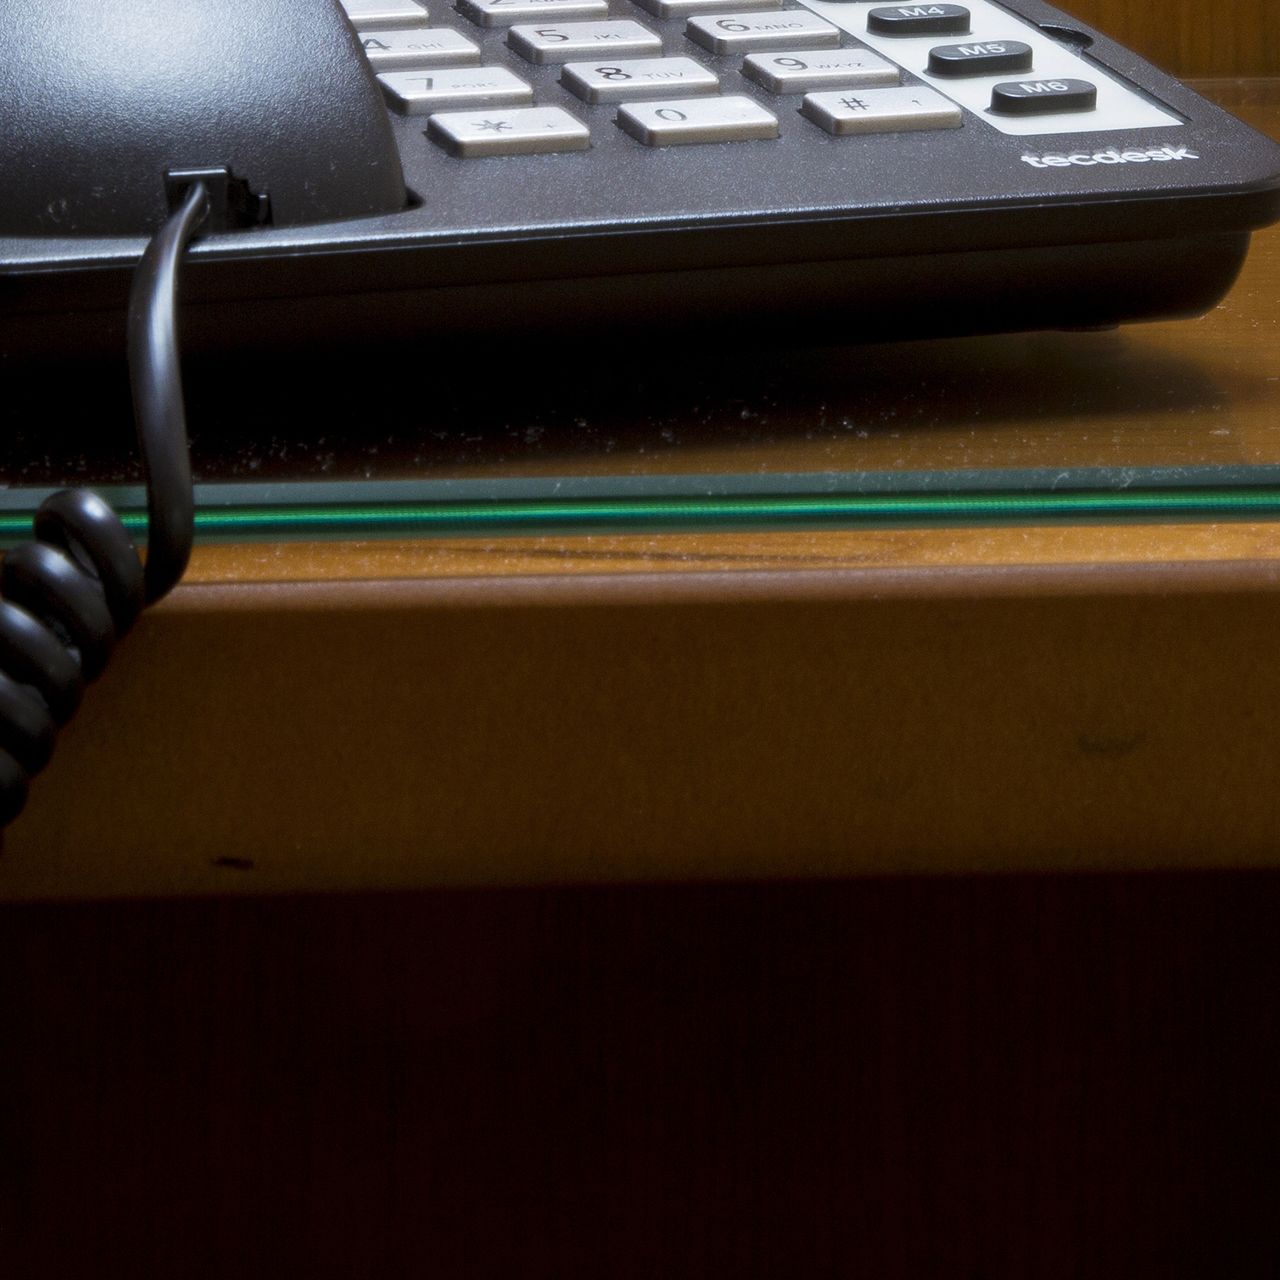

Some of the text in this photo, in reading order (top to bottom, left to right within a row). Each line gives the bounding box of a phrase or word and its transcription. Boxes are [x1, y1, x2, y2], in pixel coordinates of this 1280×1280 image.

[897, 6, 946, 18] M4
[715, 20, 751, 33] 6
[535, 29, 570, 43] 5
[958, 43, 1008, 58] M5
[773, 57, 809, 71] 9
[595, 67, 633, 81] 8
[406, 77, 434, 91] 7
[1019, 81, 1069, 95] M6
[654, 108, 689, 122] 0
[1021, 146, 1200, 169] tecdesk
